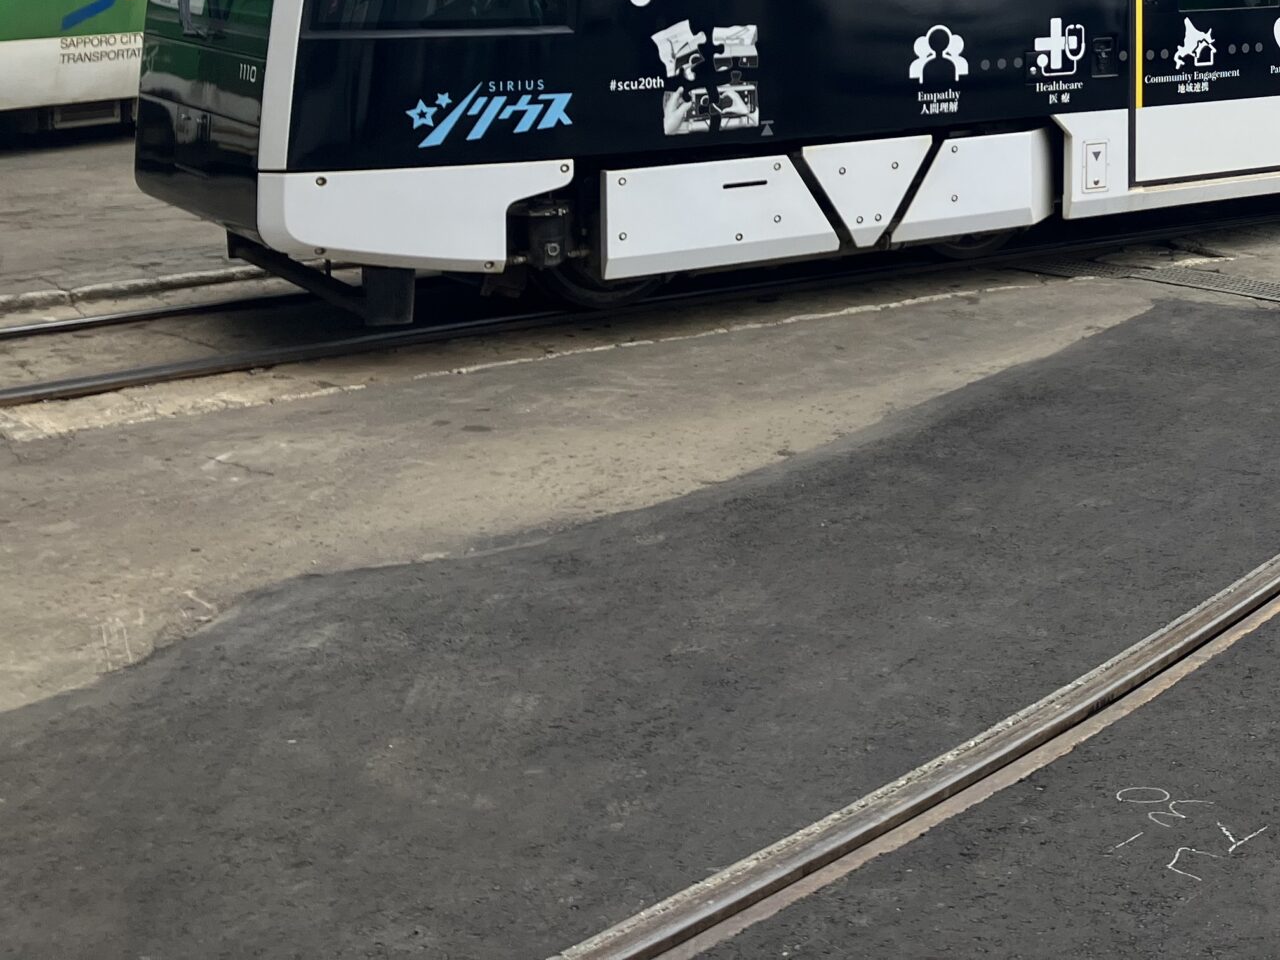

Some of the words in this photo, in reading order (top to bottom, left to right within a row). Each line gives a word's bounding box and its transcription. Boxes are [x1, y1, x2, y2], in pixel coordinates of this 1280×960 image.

[60, 34, 117, 49] SAPPORO
[239, 62, 257, 83] 1110
[1144, 71, 1193, 84] Community
[1193, 69, 1240, 81] Engagement
[488, 79, 545, 92] SIRIUS
[609, 76, 665, 91] #scu20th
[1035, 80, 1083, 92] Healthcare
[1177, 82, 1209, 93] 地域連携
[918, 89, 960, 103] Empathy
[1048, 93, 1070, 104] 医療
[920, 101, 958, 115] 人間理解
